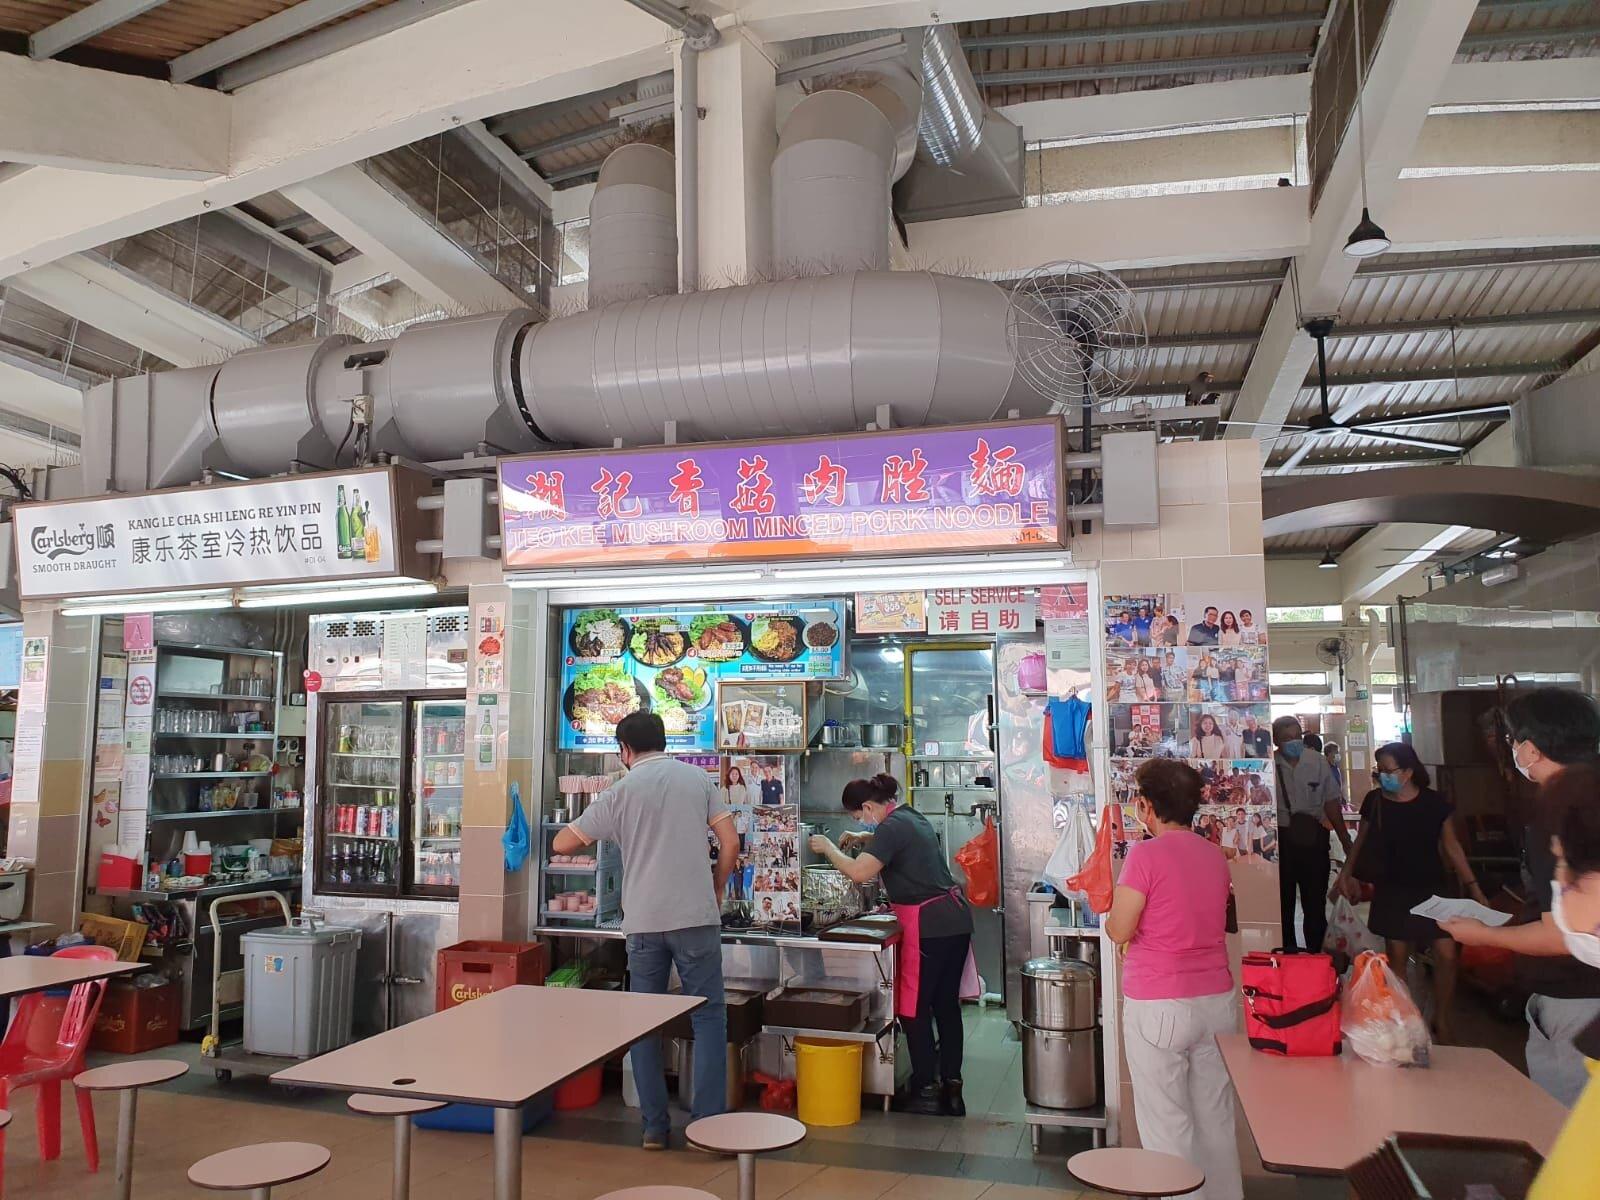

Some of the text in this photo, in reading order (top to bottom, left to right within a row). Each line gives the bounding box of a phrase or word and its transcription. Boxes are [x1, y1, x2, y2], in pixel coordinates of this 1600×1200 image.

[128, 502, 321, 531] KANG LE CHA SHI LENG RE YIN PIN
[511, 501, 1049, 548] TEO KEE MUSHROOM MINCED PORK NOODLE
[31, 525, 95, 559] Carlsberg
[131, 523, 323, 565] 康乐茶室冷热饮品
[33, 559, 117, 574] SMOOTH DRAUGHT
[935, 586, 1025, 606] SELF SERVICE
[939, 609, 1020, 631] 请自助
